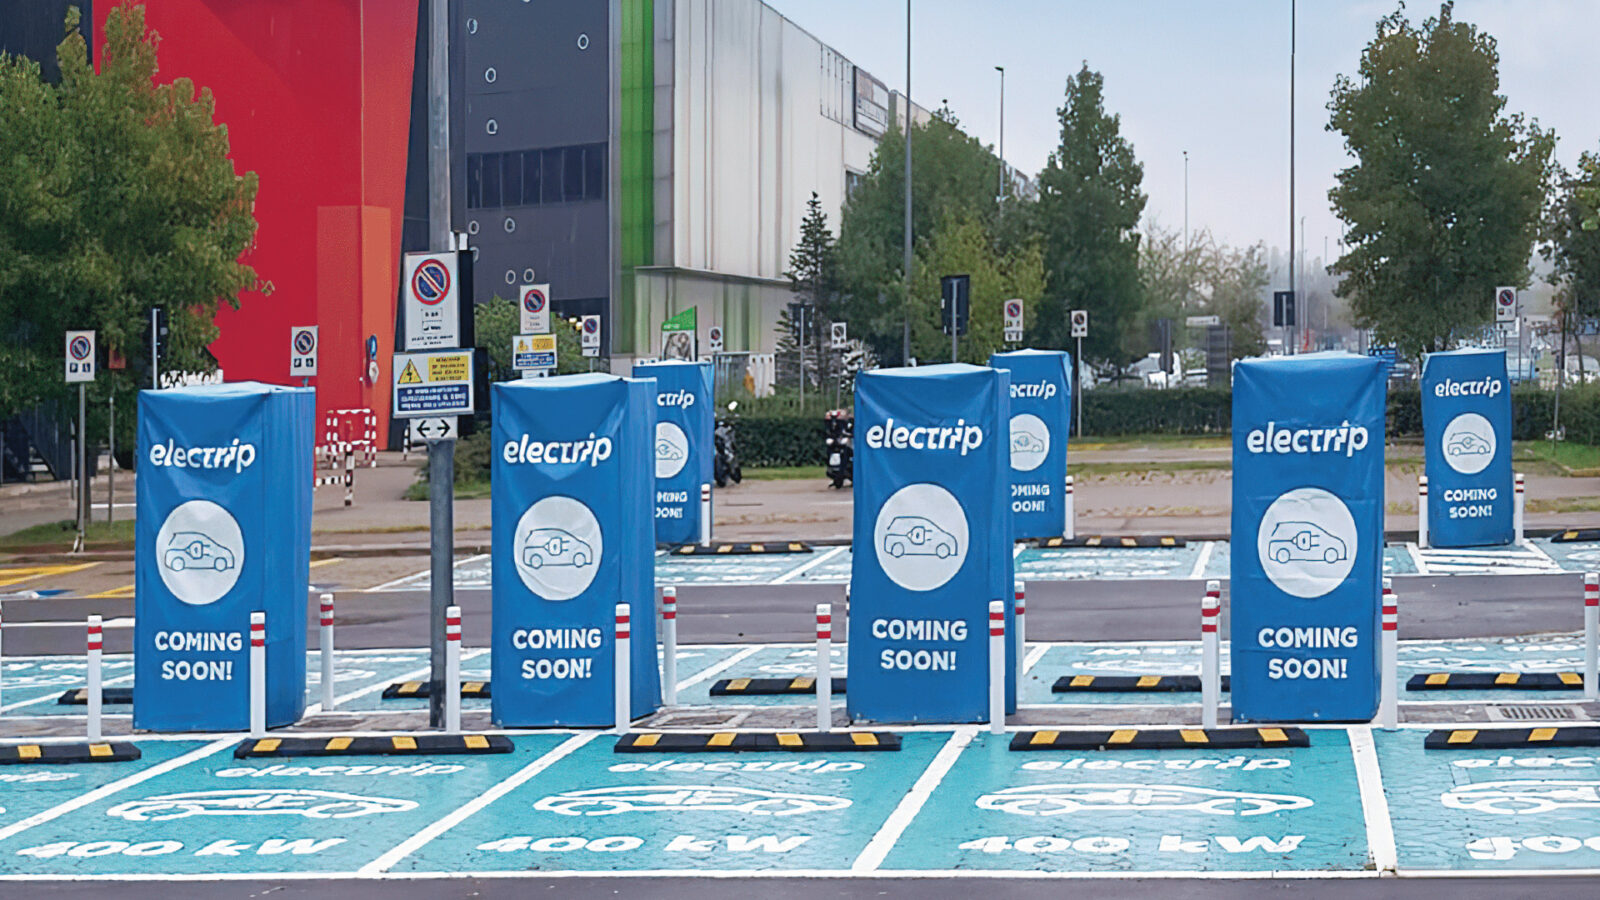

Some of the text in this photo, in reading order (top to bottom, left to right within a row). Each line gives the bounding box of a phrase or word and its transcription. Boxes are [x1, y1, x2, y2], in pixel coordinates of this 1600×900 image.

[1435, 377, 1502, 398] electrip
[867, 418, 983, 456] electrip
[1248, 420, 1369, 457] electrip
[150, 438, 256, 475] electrip
[503, 433, 612, 467] electrip
[1449, 505, 1493, 519] SOON!
[512, 628, 602, 650] COMING
[872, 619, 968, 641] COMING
[1258, 626, 1358, 648] COMING
[154, 631, 242, 652] COMING
[161, 660, 233, 681] SOON!
[521, 658, 592, 680] SOON!
[881, 650, 956, 671] SOON!
[1268, 657, 1348, 680] SOON!
[608, 760, 866, 774] electrip
[1022, 756, 1292, 771] electrip
[16, 838, 349, 858] 400 kW
[476, 835, 812, 853] 400 kW
[958, 835, 1306, 853] 400 kW
